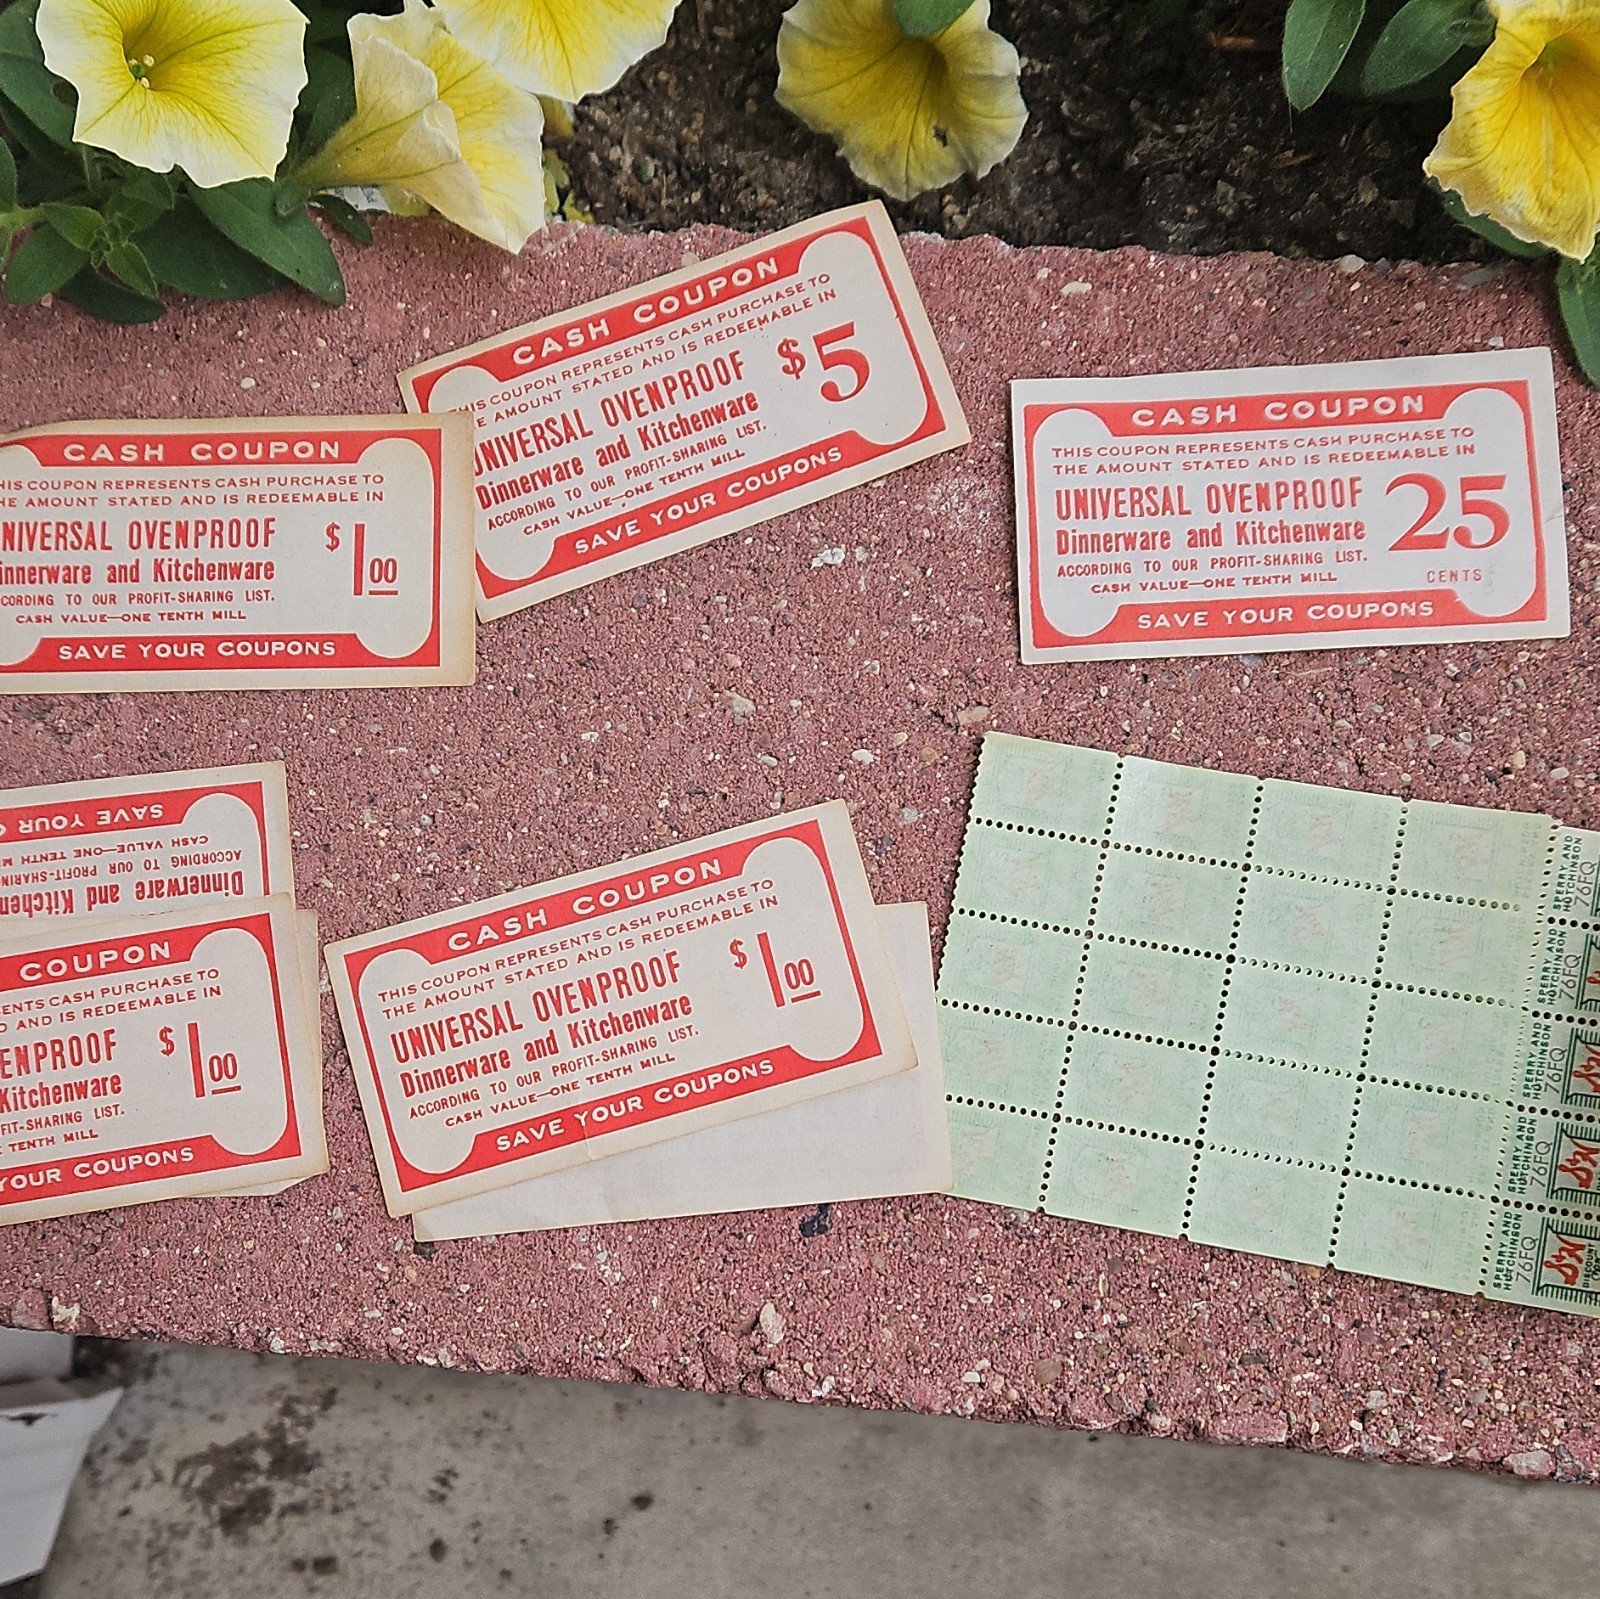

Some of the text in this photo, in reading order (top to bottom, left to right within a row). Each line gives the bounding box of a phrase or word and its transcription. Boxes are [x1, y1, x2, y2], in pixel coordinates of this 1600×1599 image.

[512, 256, 778, 365] CASH COUPON
[488, 281, 806, 405] COUPON REPRESENTS CASH PURCHASE
[493, 296, 814, 423] AMOUNT STATED AND REDEEMABLE
[599, 348, 744, 428] OVENPROOF
[1131, 393, 1423, 427] CASH COUPON
[62, 440, 339, 462] CASH COUPON
[474, 391, 759, 510] Dinnerware and Kitchenware
[1050, 425, 1474, 458] THIS COUPON REPRESENTS CASH PURCHASE TO
[1051, 442, 1475, 476] THE AMOUNT STATED AND IS REDEEMABLE IN
[26, 473, 358, 491] COUPON REPRESENTS CASH PURCHASE
[487, 418, 767, 531] ACCORDING OUR PROFIT-SHARING LIST.
[522, 447, 746, 536] CASH TENTH MILL
[24, 490, 359, 508] AMOUNT STATED AND REDEEMABLE
[574, 446, 842, 554] SAVE YOUR COUPONS
[1054, 475, 1363, 521] UNIVERSAL OVENPROOF
[1384, 472, 1510, 552] 25
[127, 516, 276, 551] OVENPROOF
[1055, 518, 1366, 556] Dinnerware and Kitchenware
[106, 556, 275, 584] and Kitchenware
[1056, 548, 1368, 578] ACCORDING TO OUR PROFIT-SHARING LIST.
[1089, 581, 1131, 594] CASH
[1241, 573, 1292, 586] TENTH
[1299, 570, 1338, 583] MILL
[1425, 567, 1482, 584] CENTS
[14, 609, 247, 624] CASH TENTH MILL
[127, 588, 275, 605] PROFIT-SHARING LIST.
[1136, 600, 1433, 629] SAVE YOUR COUPONS
[58, 640, 335, 660] SAVE YOUR COUPONS
[17, 803, 163, 834] SAVE YOUR
[169, 848, 242, 869] ACCORDING
[170, 834, 209, 848] CASH
[85, 869, 244, 912] Dinnerware and
[1553, 835, 1573, 910] SPERRY AND
[1573, 861, 1597, 907] 76FQ
[447, 857, 722, 951] CASH COUPON
[18, 940, 171, 981] COUPON
[376, 878, 774, 1003] THIS COUPON REPRESENTS CASH PURCHASE TO
[380, 894, 779, 1020] THE AMOUNT STATED AND IS REDEEMABLE IN
[1537, 928, 1557, 1004] SPERRY AND
[1558, 954, 1581, 1001] 76FQ
[15, 988, 197, 1031] AND REDEEMABLE
[47, 988, 95, 1007] CASH
[99, 971, 194, 999] PURCHASE
[389, 949, 680, 1064] UNIVERSAL OVENPROOF
[398, 994, 692, 1098] Dinnerware and Kitchenware
[1522, 1022, 1542, 1099] SPERRY AND
[408, 1023, 699, 1120] ACCORDING TO OUR PROFIT-SHARING LIST.
[444, 1108, 483, 1127] CASH
[584, 1063, 633, 1085] TENTH
[638, 1052, 676, 1070] MILL
[1543, 1047, 1568, 1094] 76FQ
[92, 1102, 125, 1120] LIST.
[495, 1058, 774, 1151] SAVE YOUR COUPONS
[6, 1128, 99, 1153] TENTH MILL
[1516, 1116, 1528, 1140] AND
[72, 1146, 194, 1178] COUPONS
[1529, 1140, 1553, 1188] 76FQ
[1492, 1212, 1513, 1289] SPERRY AND
[1515, 1235, 1538, 1284] 76FQ
